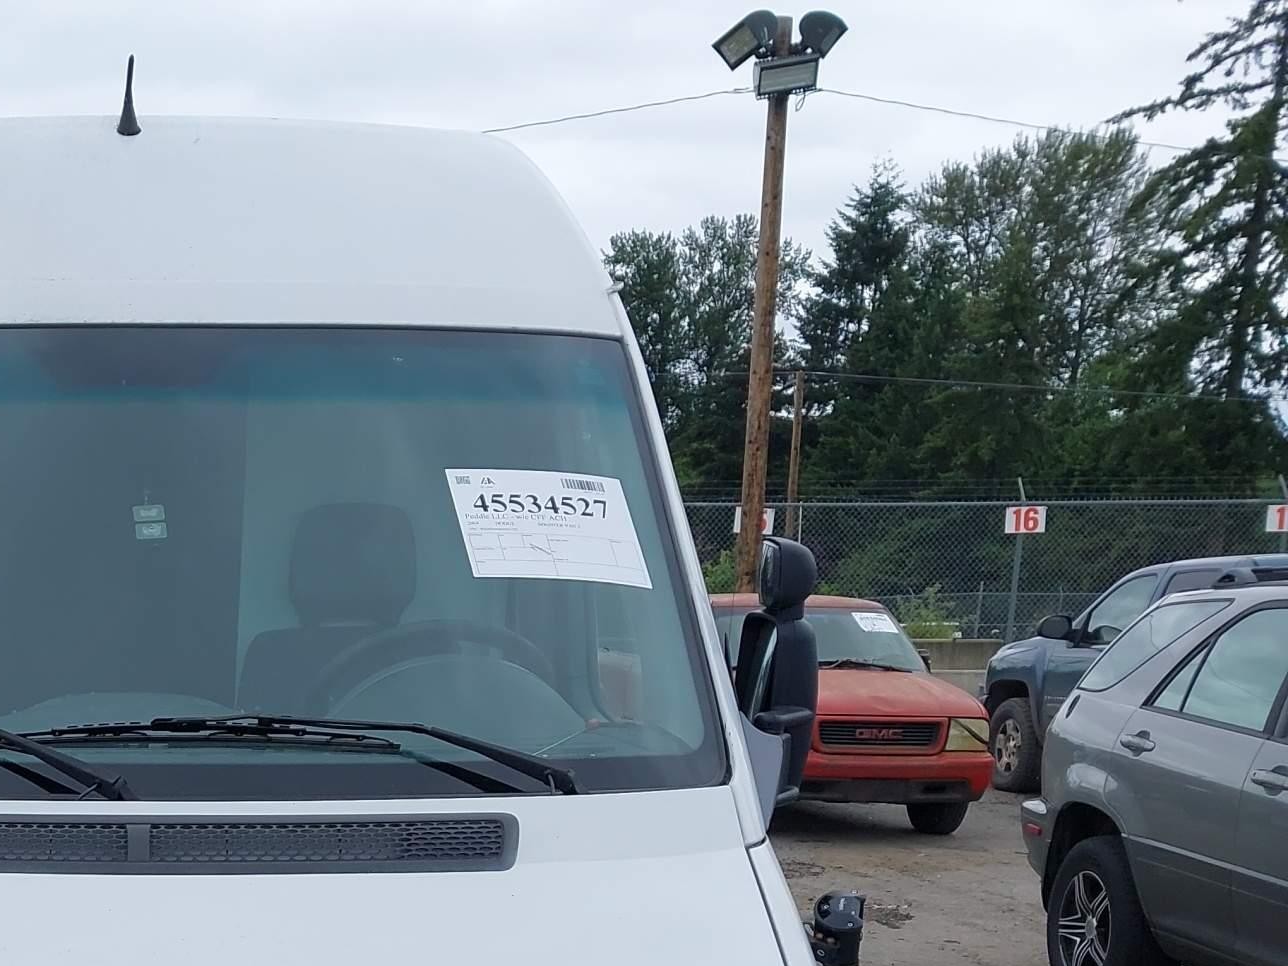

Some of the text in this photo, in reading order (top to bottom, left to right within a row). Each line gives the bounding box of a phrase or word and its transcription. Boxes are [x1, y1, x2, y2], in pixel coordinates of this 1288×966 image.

[473, 493, 607, 519] 45534527
[1013, 507, 1039, 531] 16
[1276, 507, 1288, 530] 1
[855, 728, 904, 739] GMC
